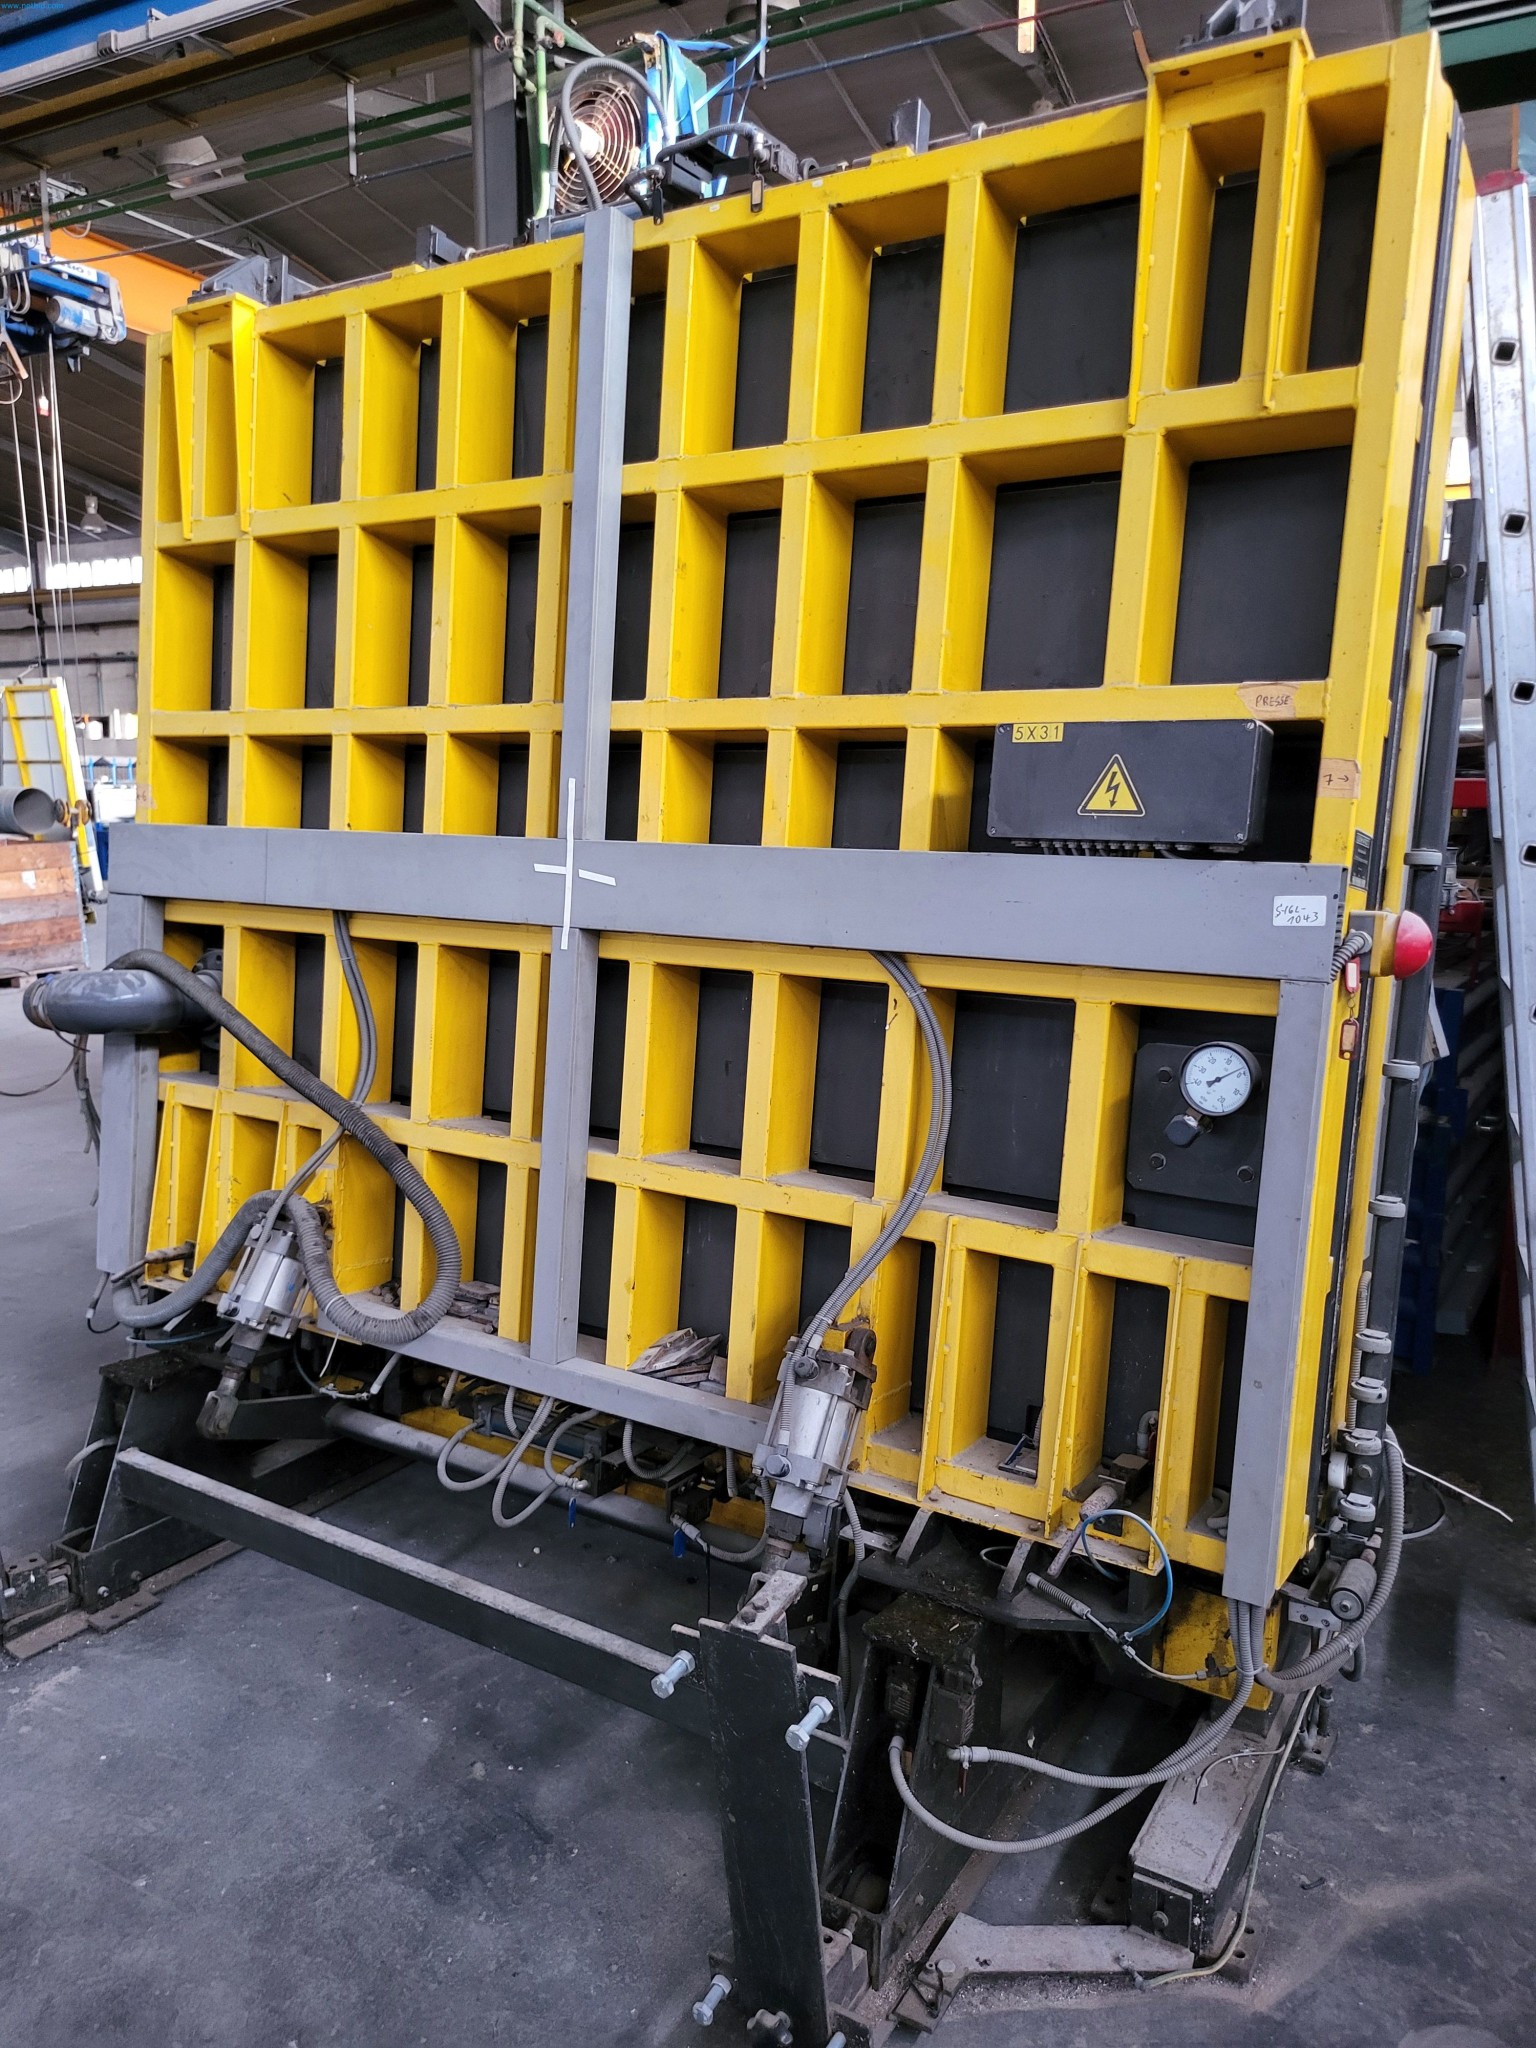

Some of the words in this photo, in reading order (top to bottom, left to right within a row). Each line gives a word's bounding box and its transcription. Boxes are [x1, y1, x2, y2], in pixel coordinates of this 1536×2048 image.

[1255, 694, 1291, 708] PRESSE
[1014, 725, 1059, 740] 5X31
[1323, 773, 1334, 786] 7
[1286, 911, 1319, 925] 1043
